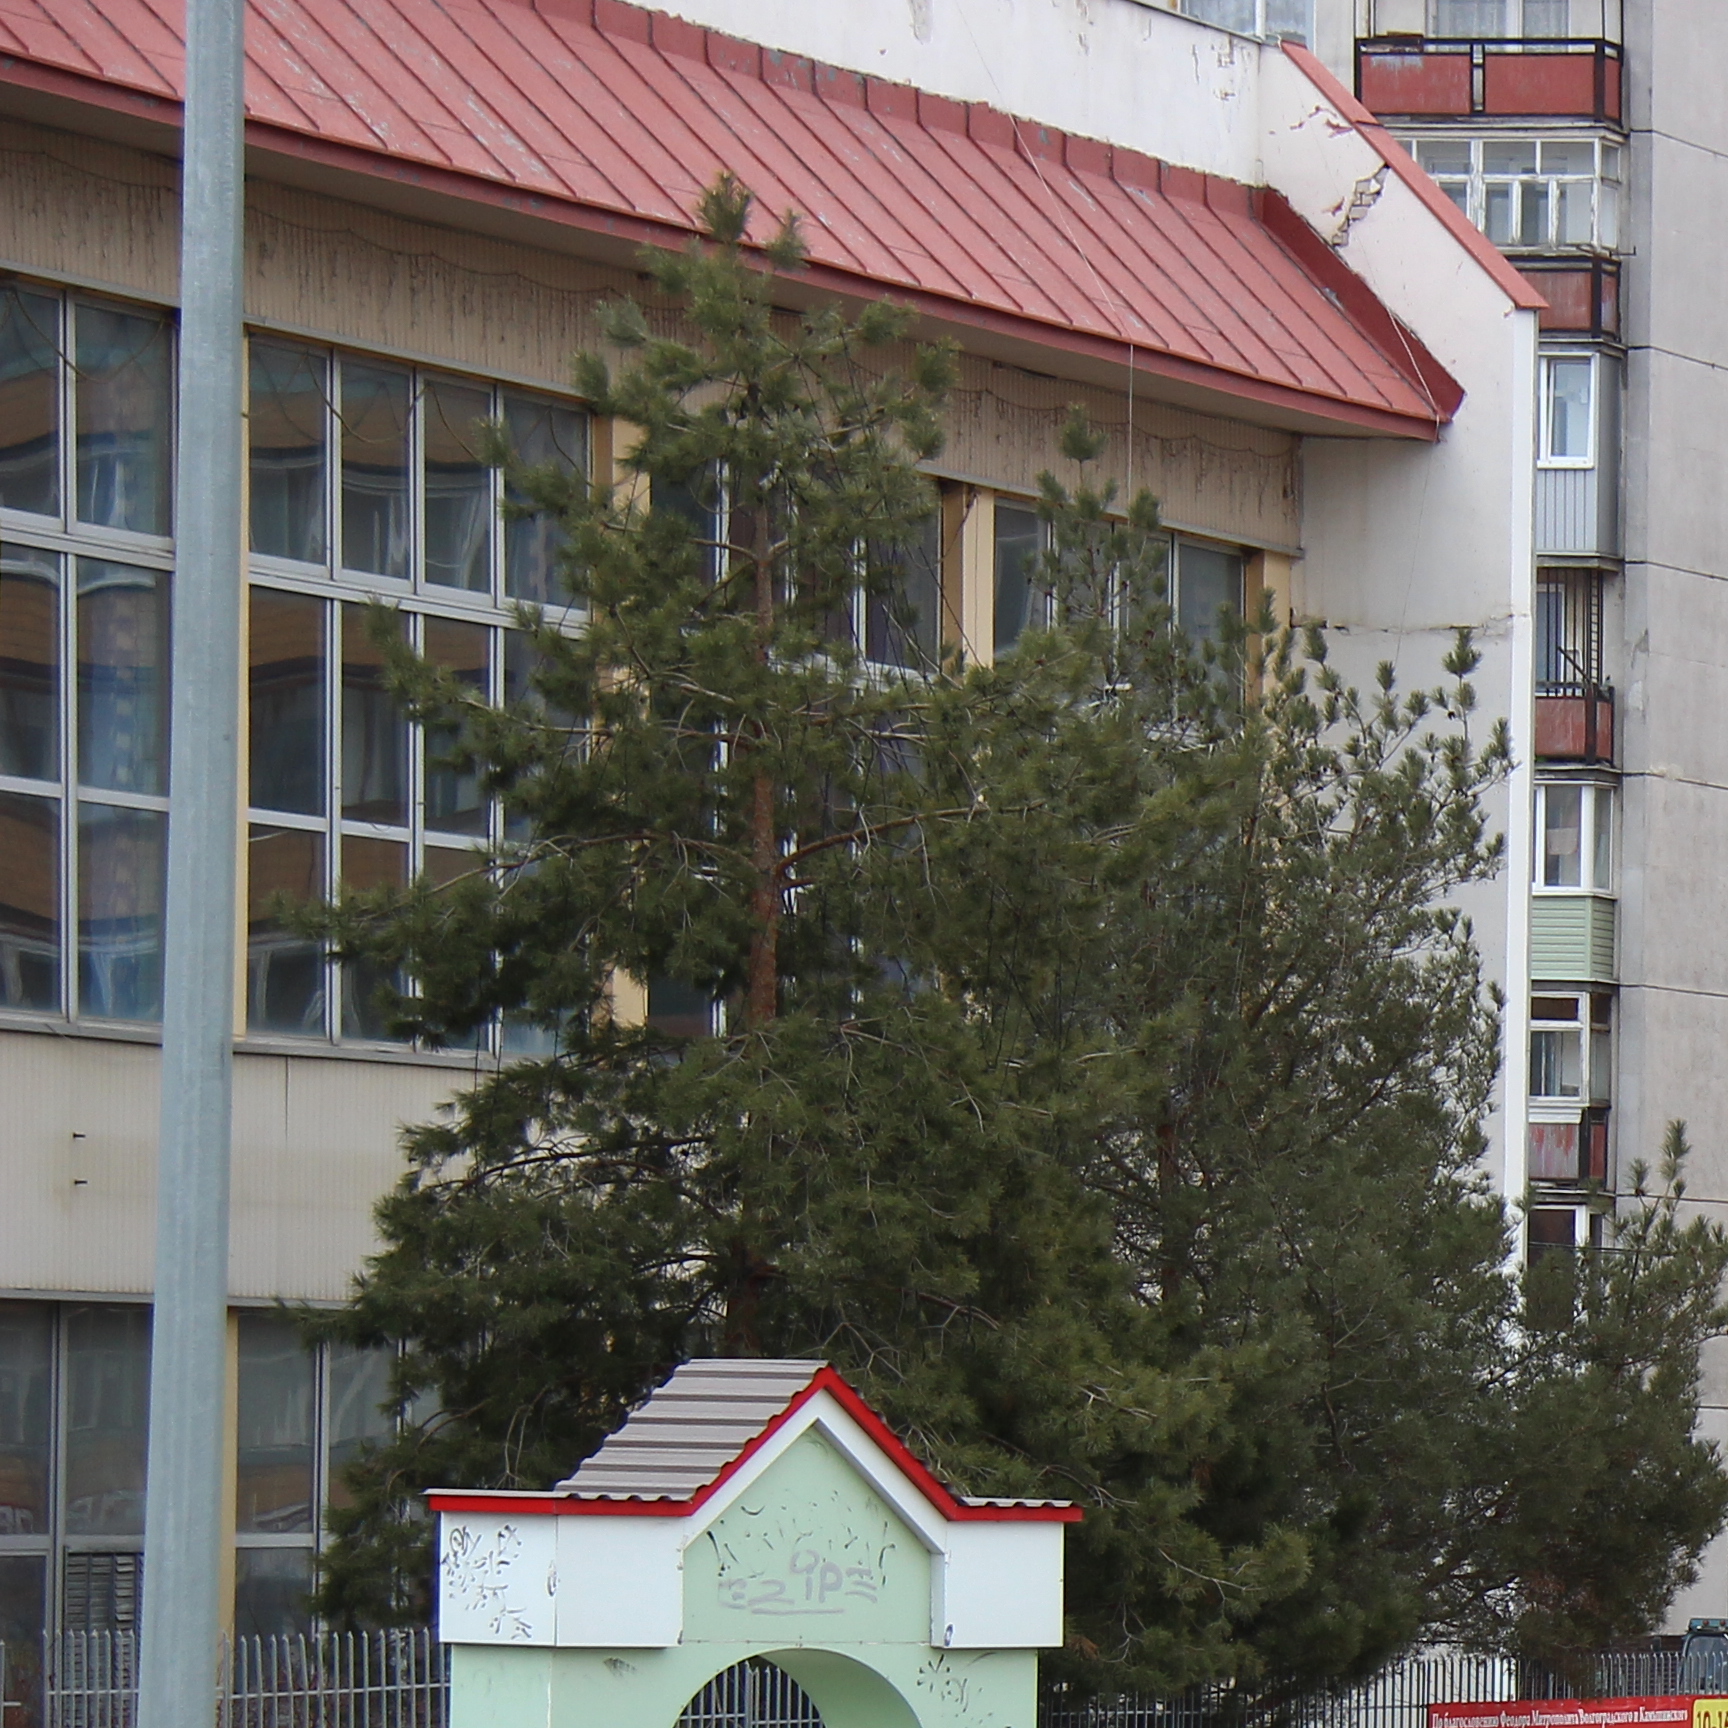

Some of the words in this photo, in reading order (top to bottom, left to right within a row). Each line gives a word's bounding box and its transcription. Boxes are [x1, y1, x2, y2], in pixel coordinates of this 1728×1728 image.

[1444, 1711, 1499, 1728] благословению
[1578, 1708, 1633, 1728] Волгоградского
[1639, 1706, 1688, 1723] Камышинского
